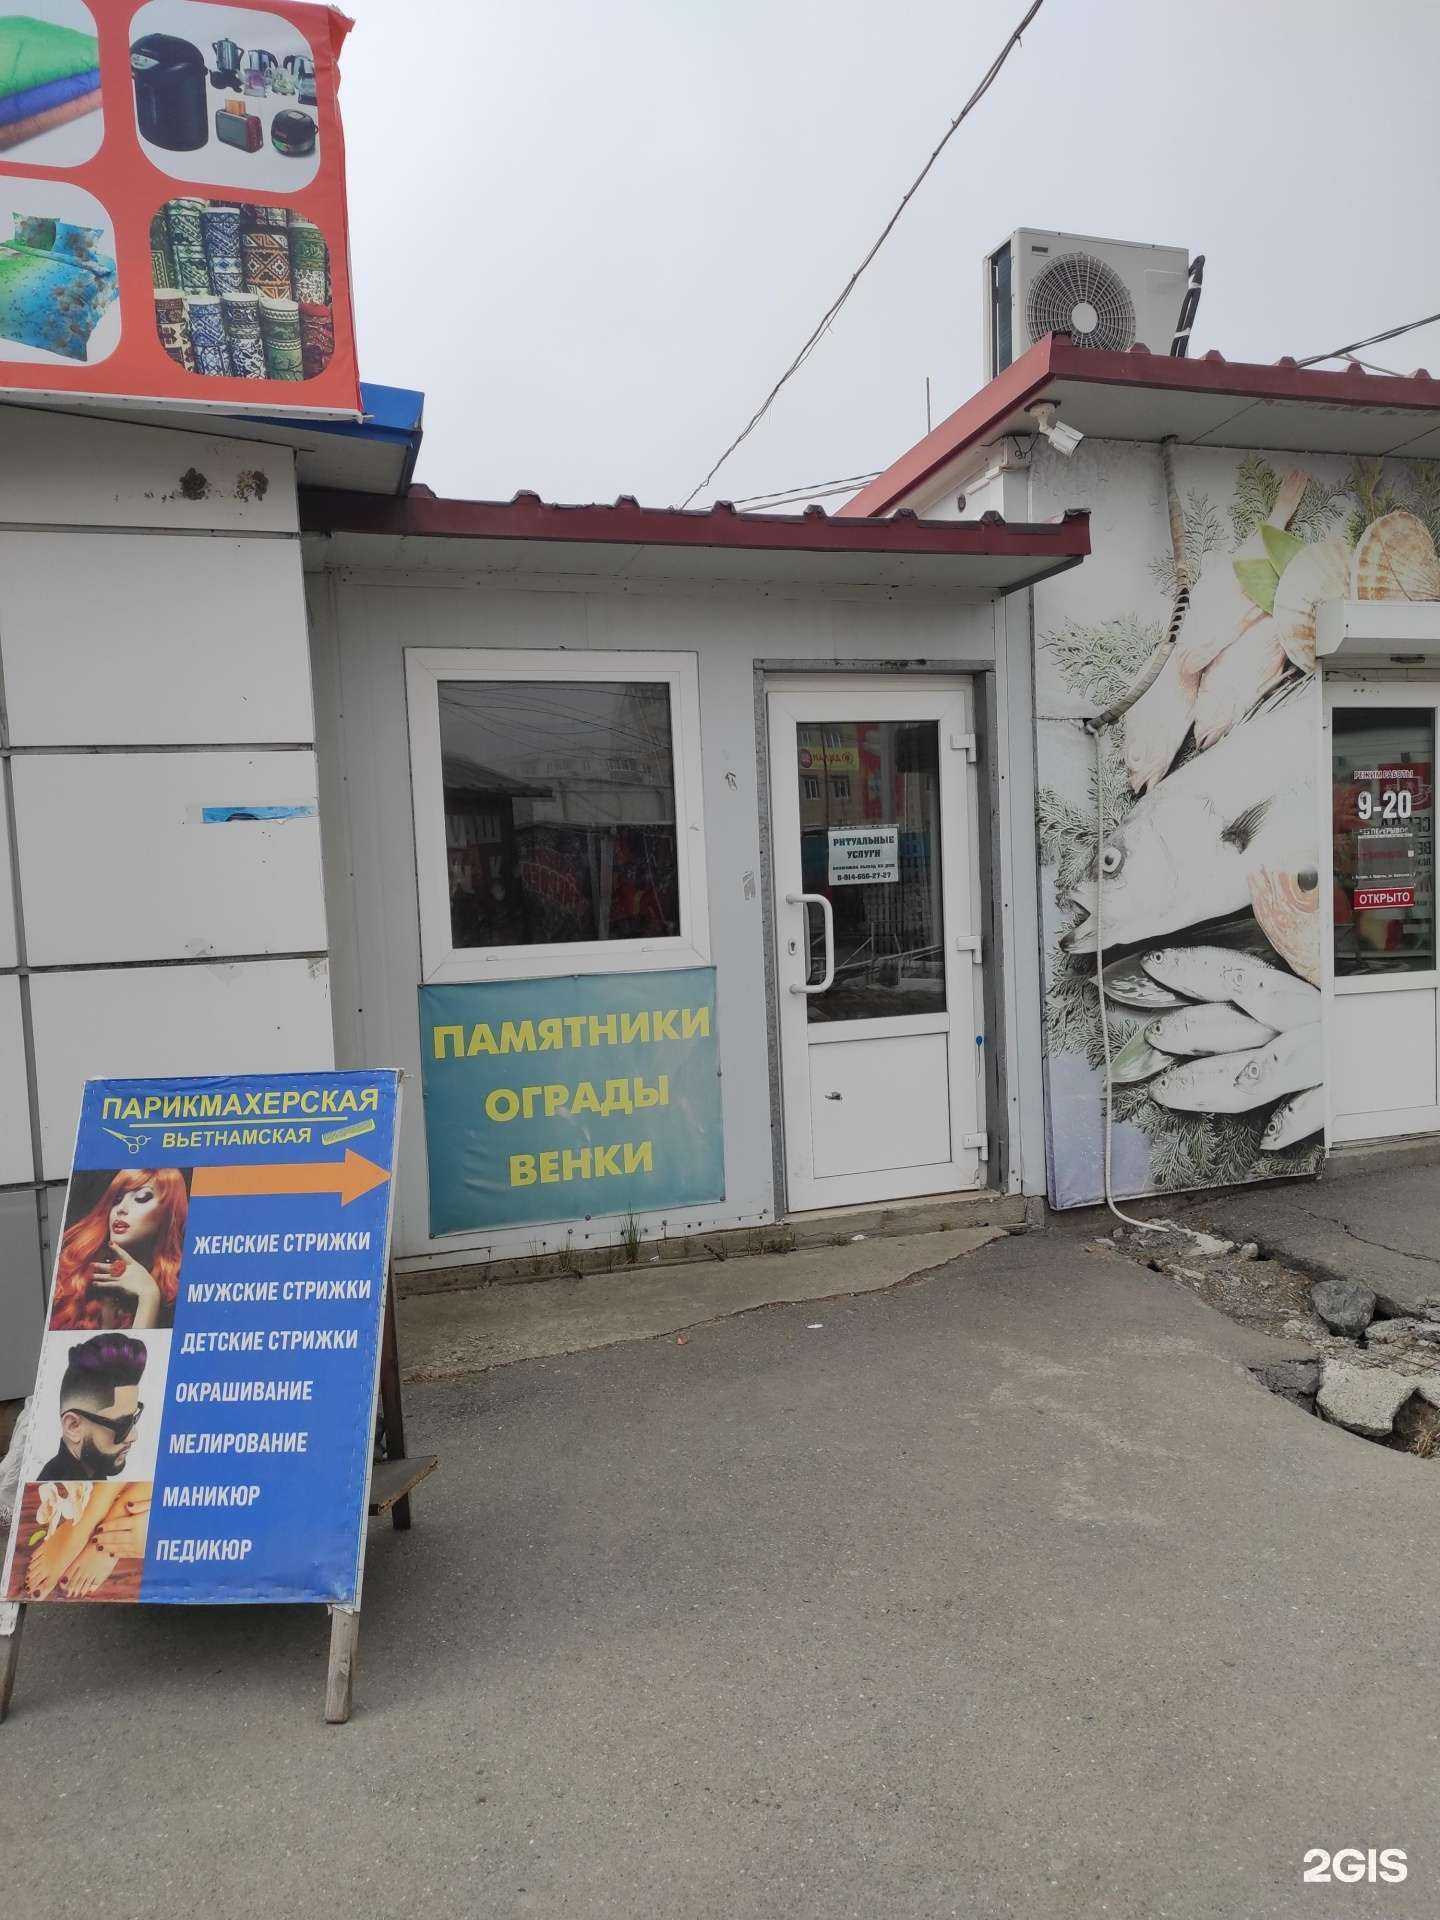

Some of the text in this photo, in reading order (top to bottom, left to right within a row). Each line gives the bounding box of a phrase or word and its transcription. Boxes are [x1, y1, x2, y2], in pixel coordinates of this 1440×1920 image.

[1358, 790, 1412, 820] 9-20
[833, 836, 895, 847] РИТУАЛЬНЫЕ
[847, 849, 881, 859] УСЛУГИ
[1359, 892, 1410, 905] ОТКРЫТО
[432, 1006, 711, 1059] ПАМЯТНИКИ
[101, 1088, 379, 1120] ПАРИКМАХЕРСКАЯ
[485, 1075, 670, 1122] ОГРАДЫ
[162, 1127, 312, 1149] ВЬЕТНАМСКАЯ
[509, 1141, 653, 1187] ВЕНКИ
[193, 1232, 371, 1255] ЖЕНСКИЕ СТРИЖКИ
[187, 1280, 371, 1303] МУЖСКИЕ СТРИЖКИ
[180, 1329, 358, 1355] ДЕТСКИЕ СТРИЖКИ
[175, 1380, 314, 1403] ОКРАШИВАНИЕ
[169, 1432, 309, 1454] МЕЛИРОВАНИЕ
[162, 1485, 261, 1507] МАНИКЮР
[156, 1539, 252, 1563] ПЕДИКЮР
